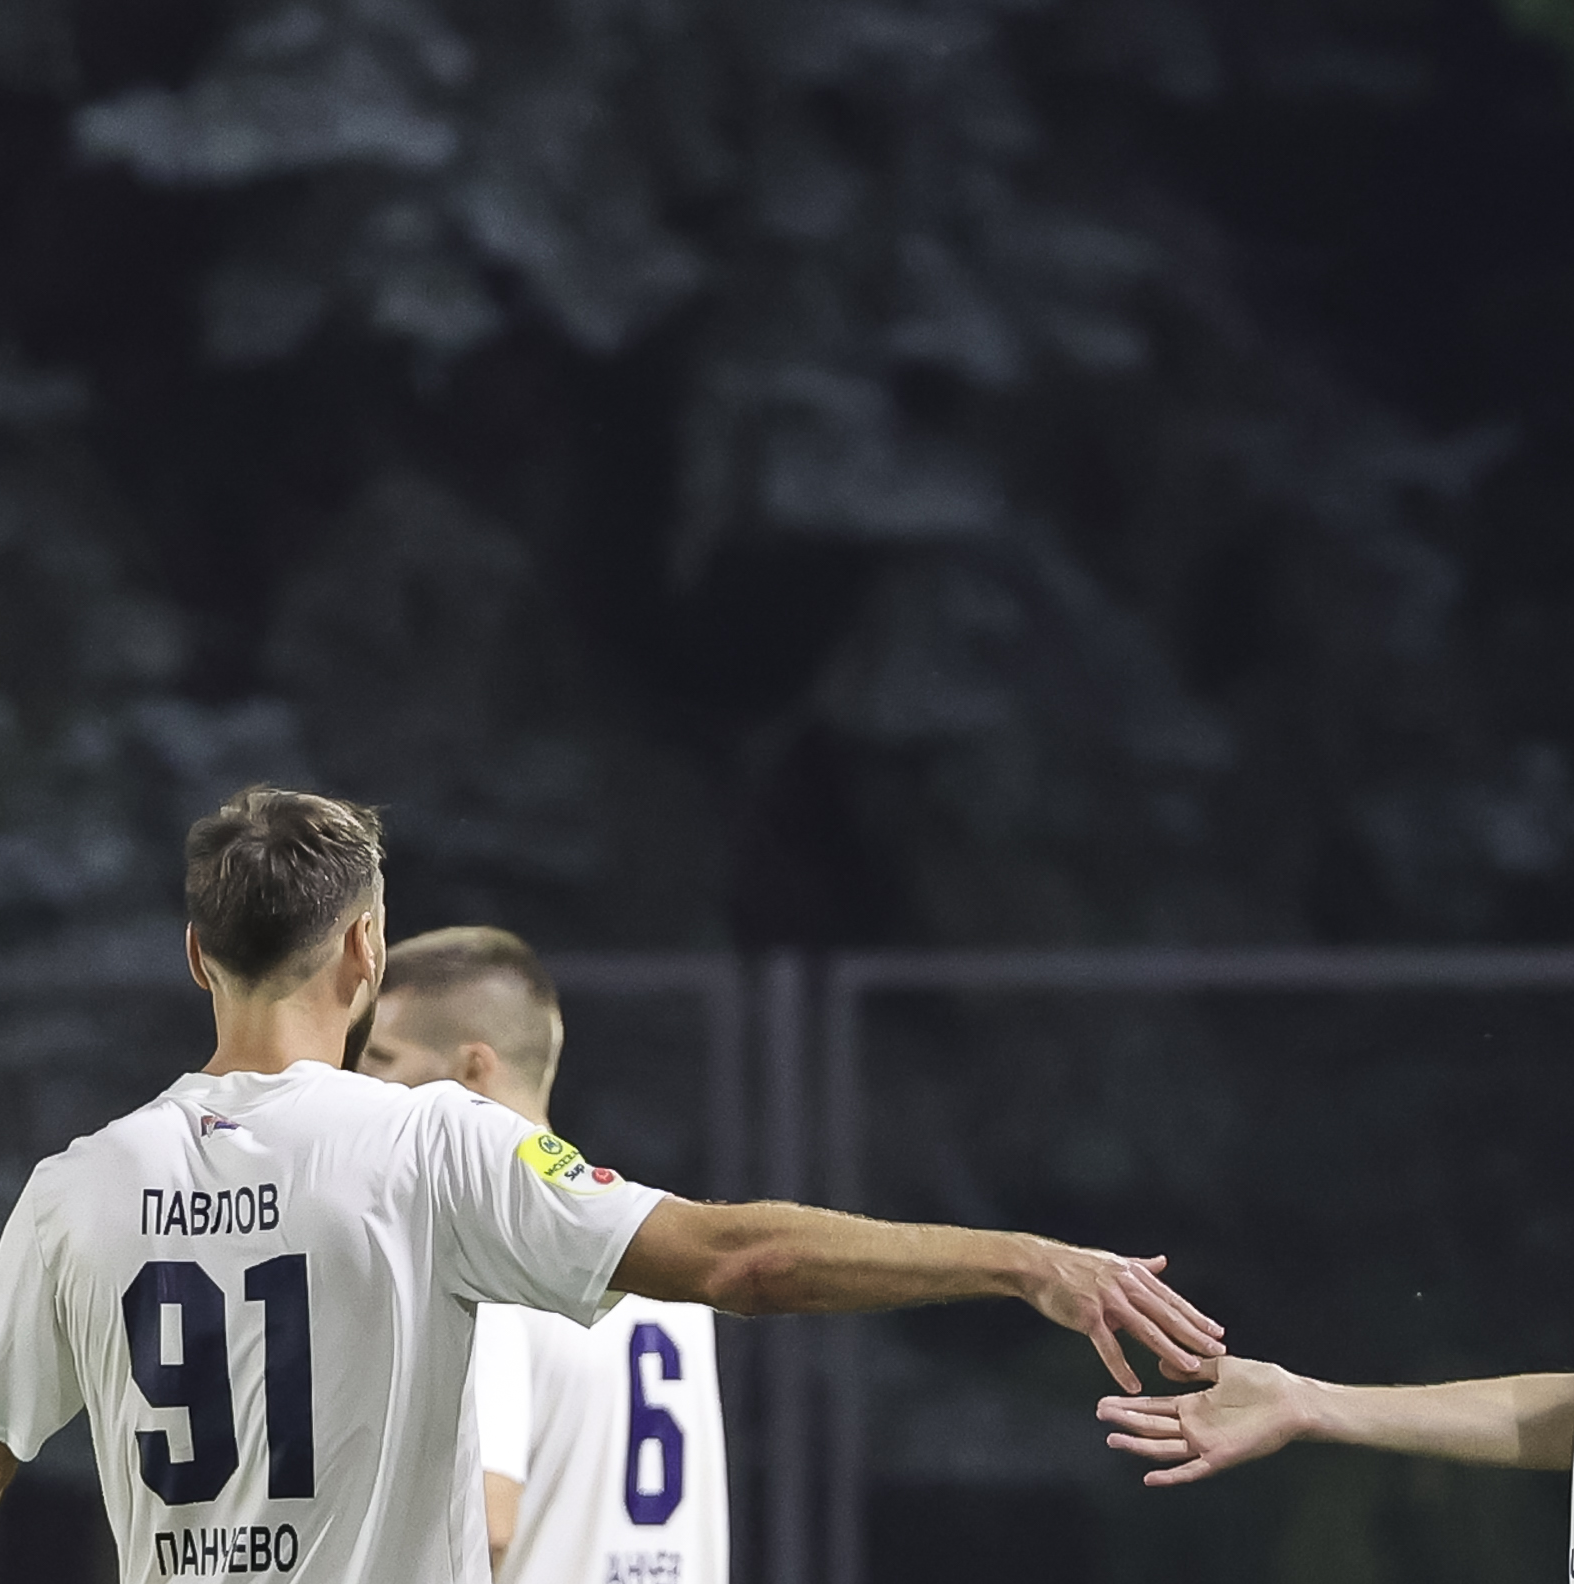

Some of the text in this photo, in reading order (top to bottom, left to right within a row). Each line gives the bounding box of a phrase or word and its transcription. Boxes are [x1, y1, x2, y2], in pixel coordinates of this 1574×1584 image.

[141, 1183, 280, 1236] ПАВЛОВ
[122, 1253, 315, 1506] 91
[625, 1323, 684, 1526] 6
[155, 1524, 299, 1576] ПАНЧЕВО
